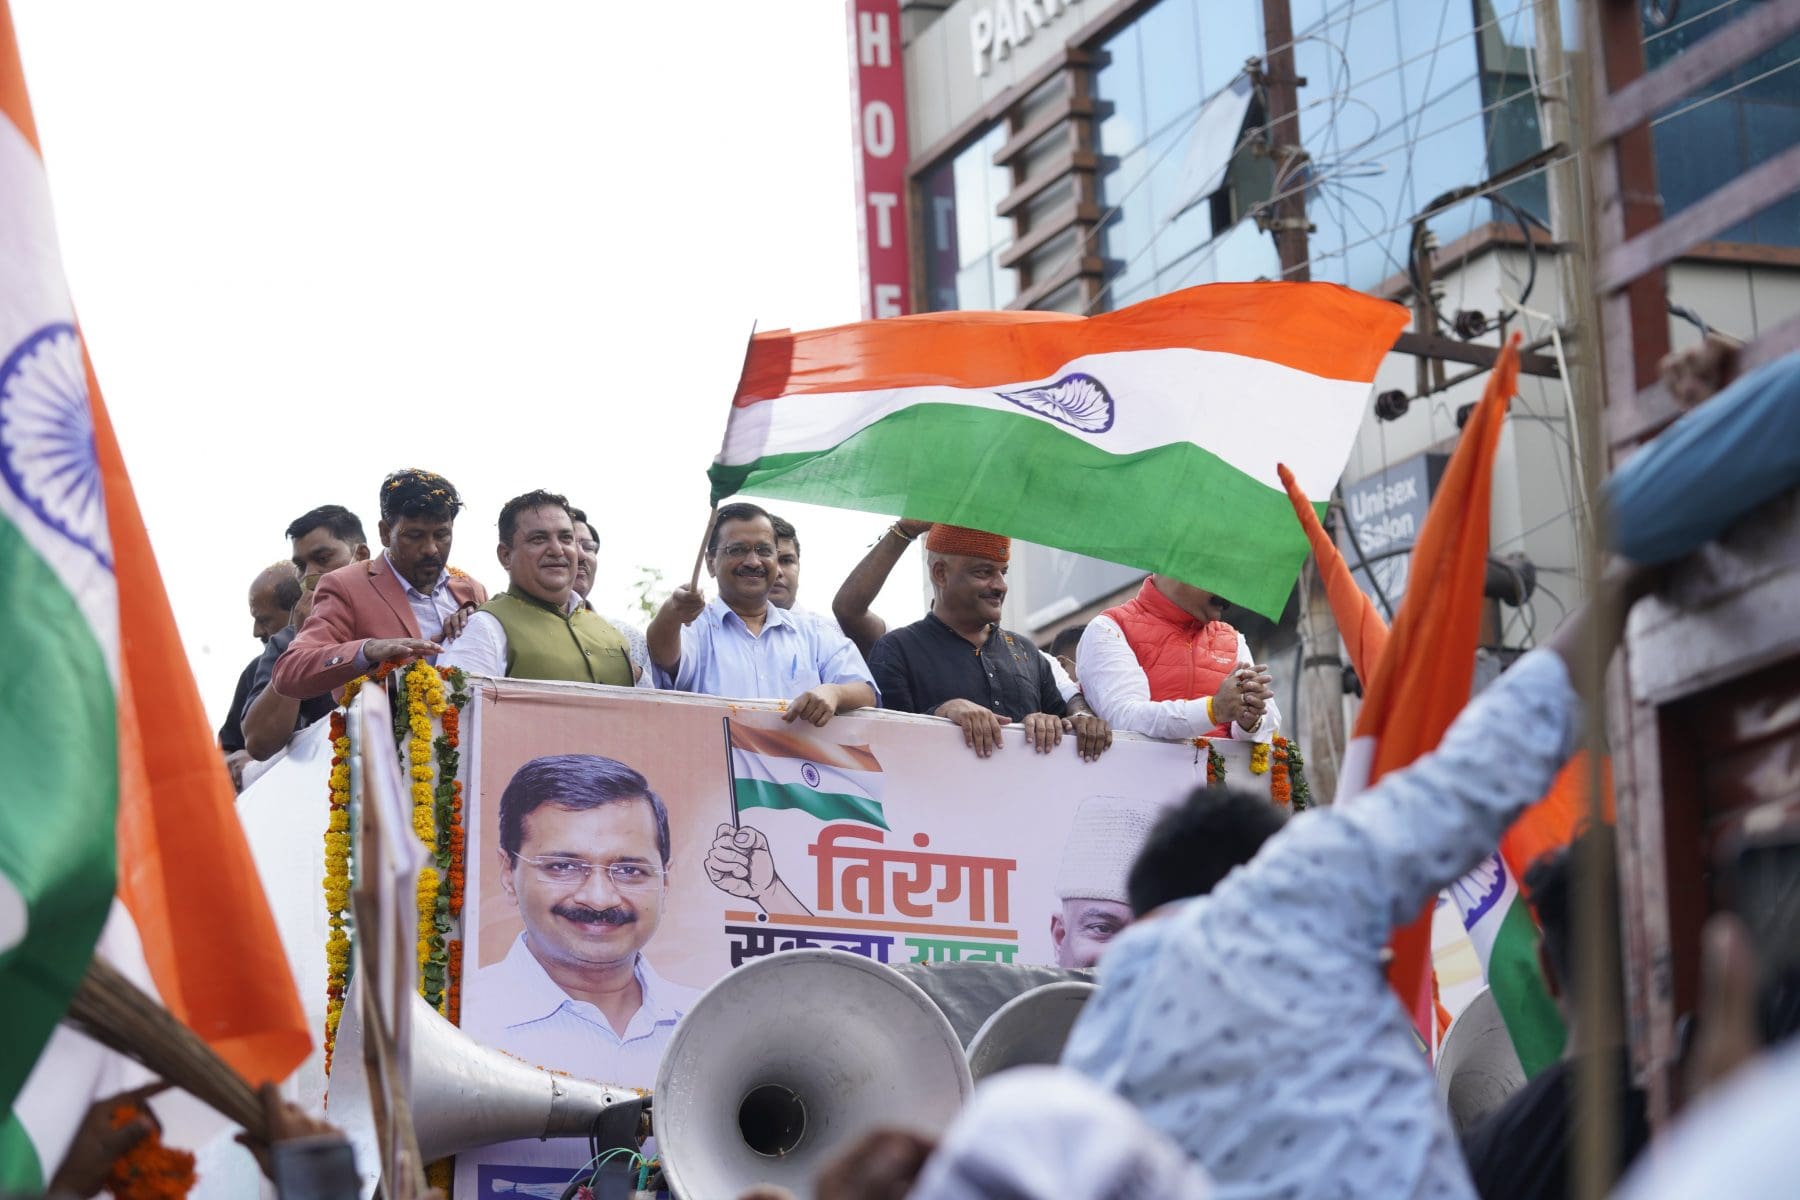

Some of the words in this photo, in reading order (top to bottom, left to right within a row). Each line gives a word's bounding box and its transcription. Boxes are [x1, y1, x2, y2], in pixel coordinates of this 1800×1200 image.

[969, 0, 1072, 76] PAR
[1351, 477, 1417, 522] Unisex
[1359, 512, 1415, 553] Salon
[807, 824, 1016, 924] तिरंगा
